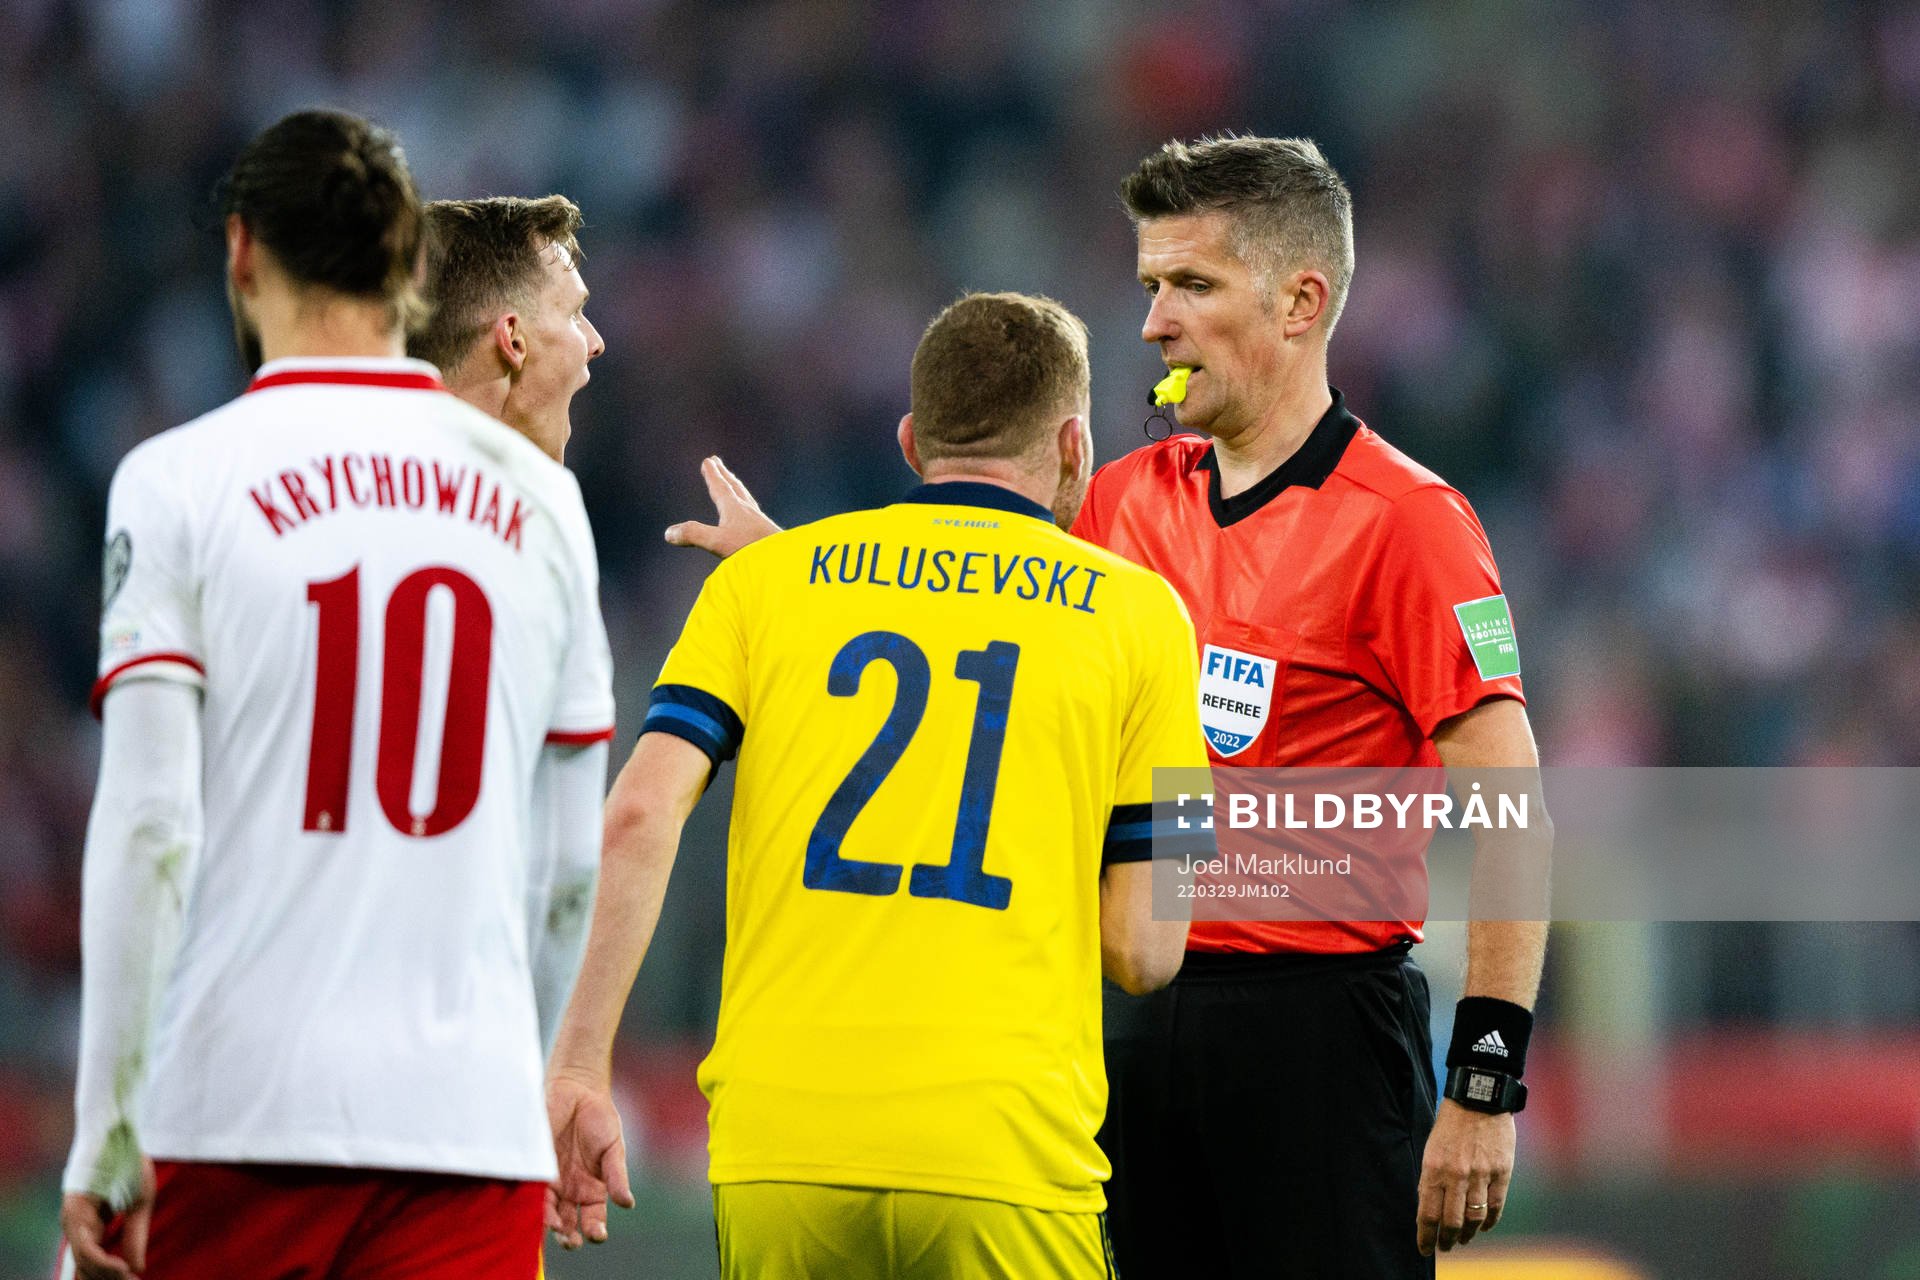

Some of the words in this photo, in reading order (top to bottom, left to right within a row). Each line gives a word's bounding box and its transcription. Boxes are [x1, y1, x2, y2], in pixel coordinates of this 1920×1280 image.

[249, 452, 537, 553] KRYCHOWIAK
[809, 542, 1106, 614] KULUSEVSKI
[1468, 617, 1508, 633] LIVING
[1471, 627, 1510, 641] FOOTBALL
[1498, 643, 1514, 654] FIFA
[1207, 651, 1265, 688] FIFA
[303, 561, 494, 839] 10
[1202, 693, 1262, 719] REFEREE
[1213, 731, 1240, 748] 2022
[803, 630, 1021, 911] 21
[1472, 1043, 1509, 1058] adidas
